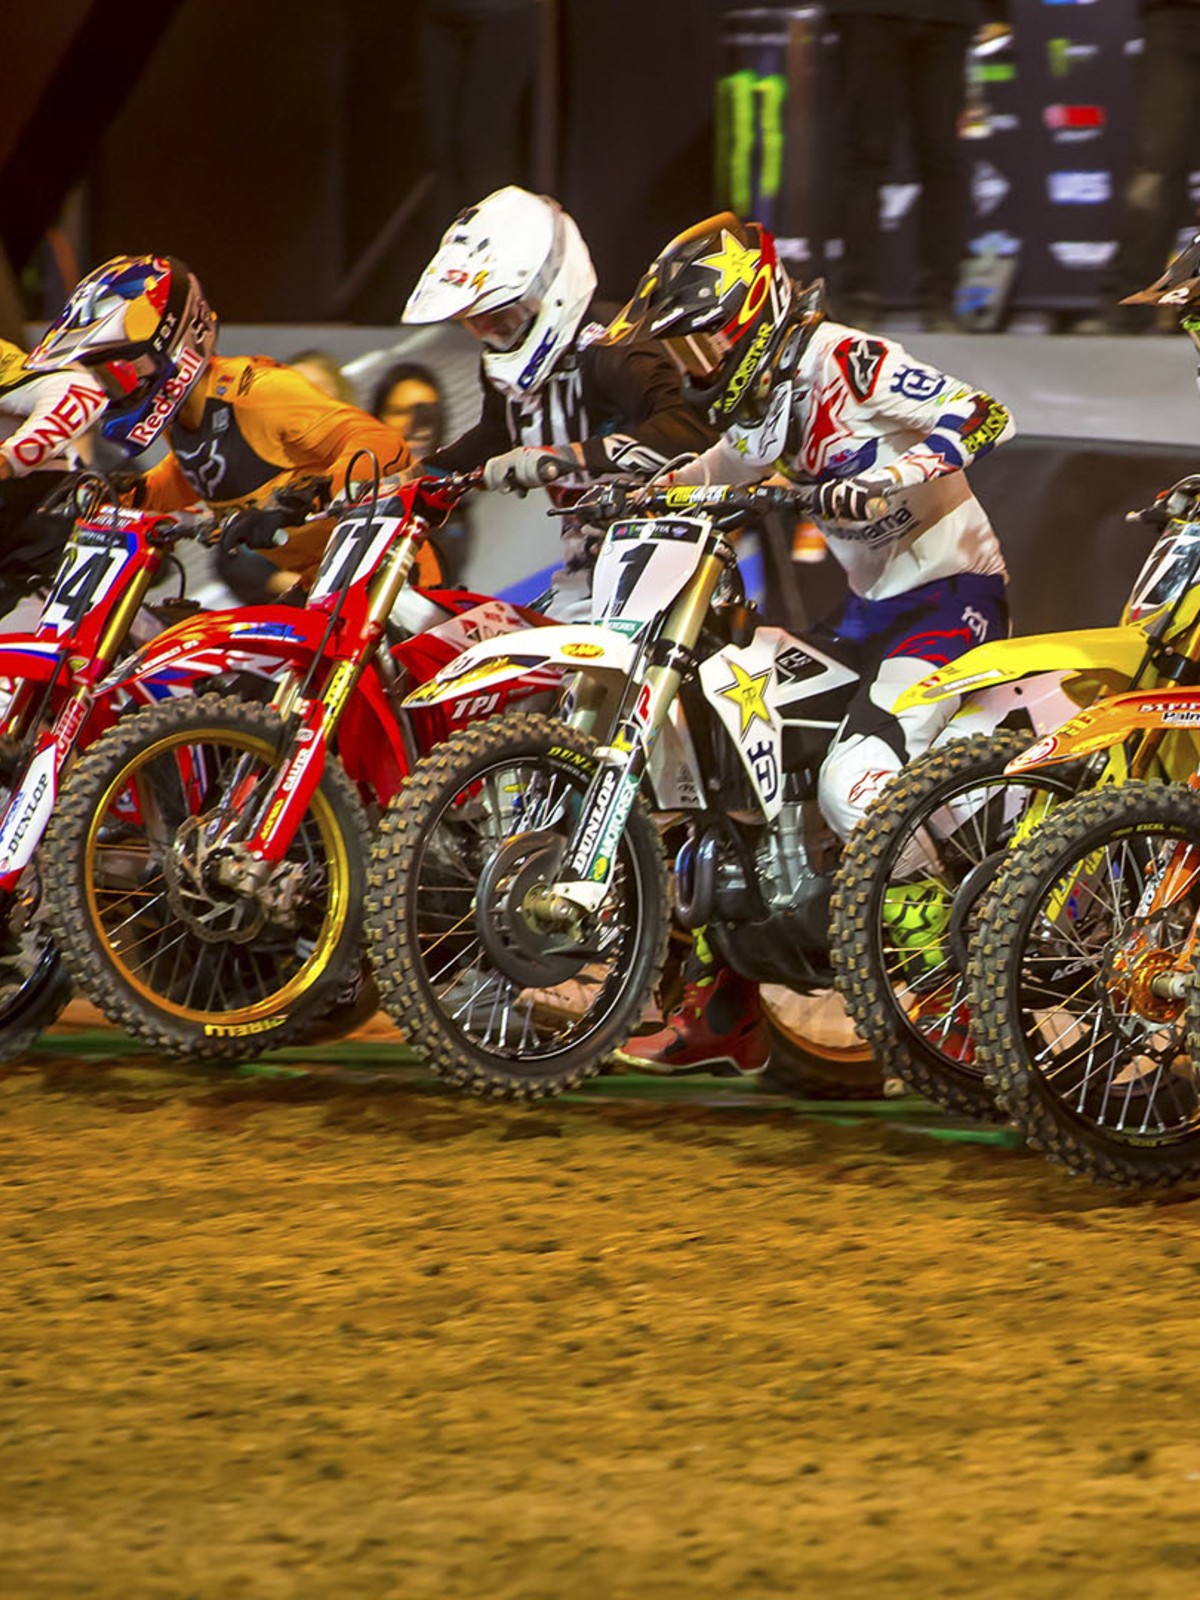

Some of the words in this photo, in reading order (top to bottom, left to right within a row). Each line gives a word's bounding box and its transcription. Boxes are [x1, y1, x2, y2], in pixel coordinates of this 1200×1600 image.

[153, 312, 178, 351] FOX
[619, 543, 660, 617] 1
[7, 772, 49, 855] DUNLOP
[571, 769, 617, 875] DUNLOP
[599, 774, 641, 857] MOTOREX
